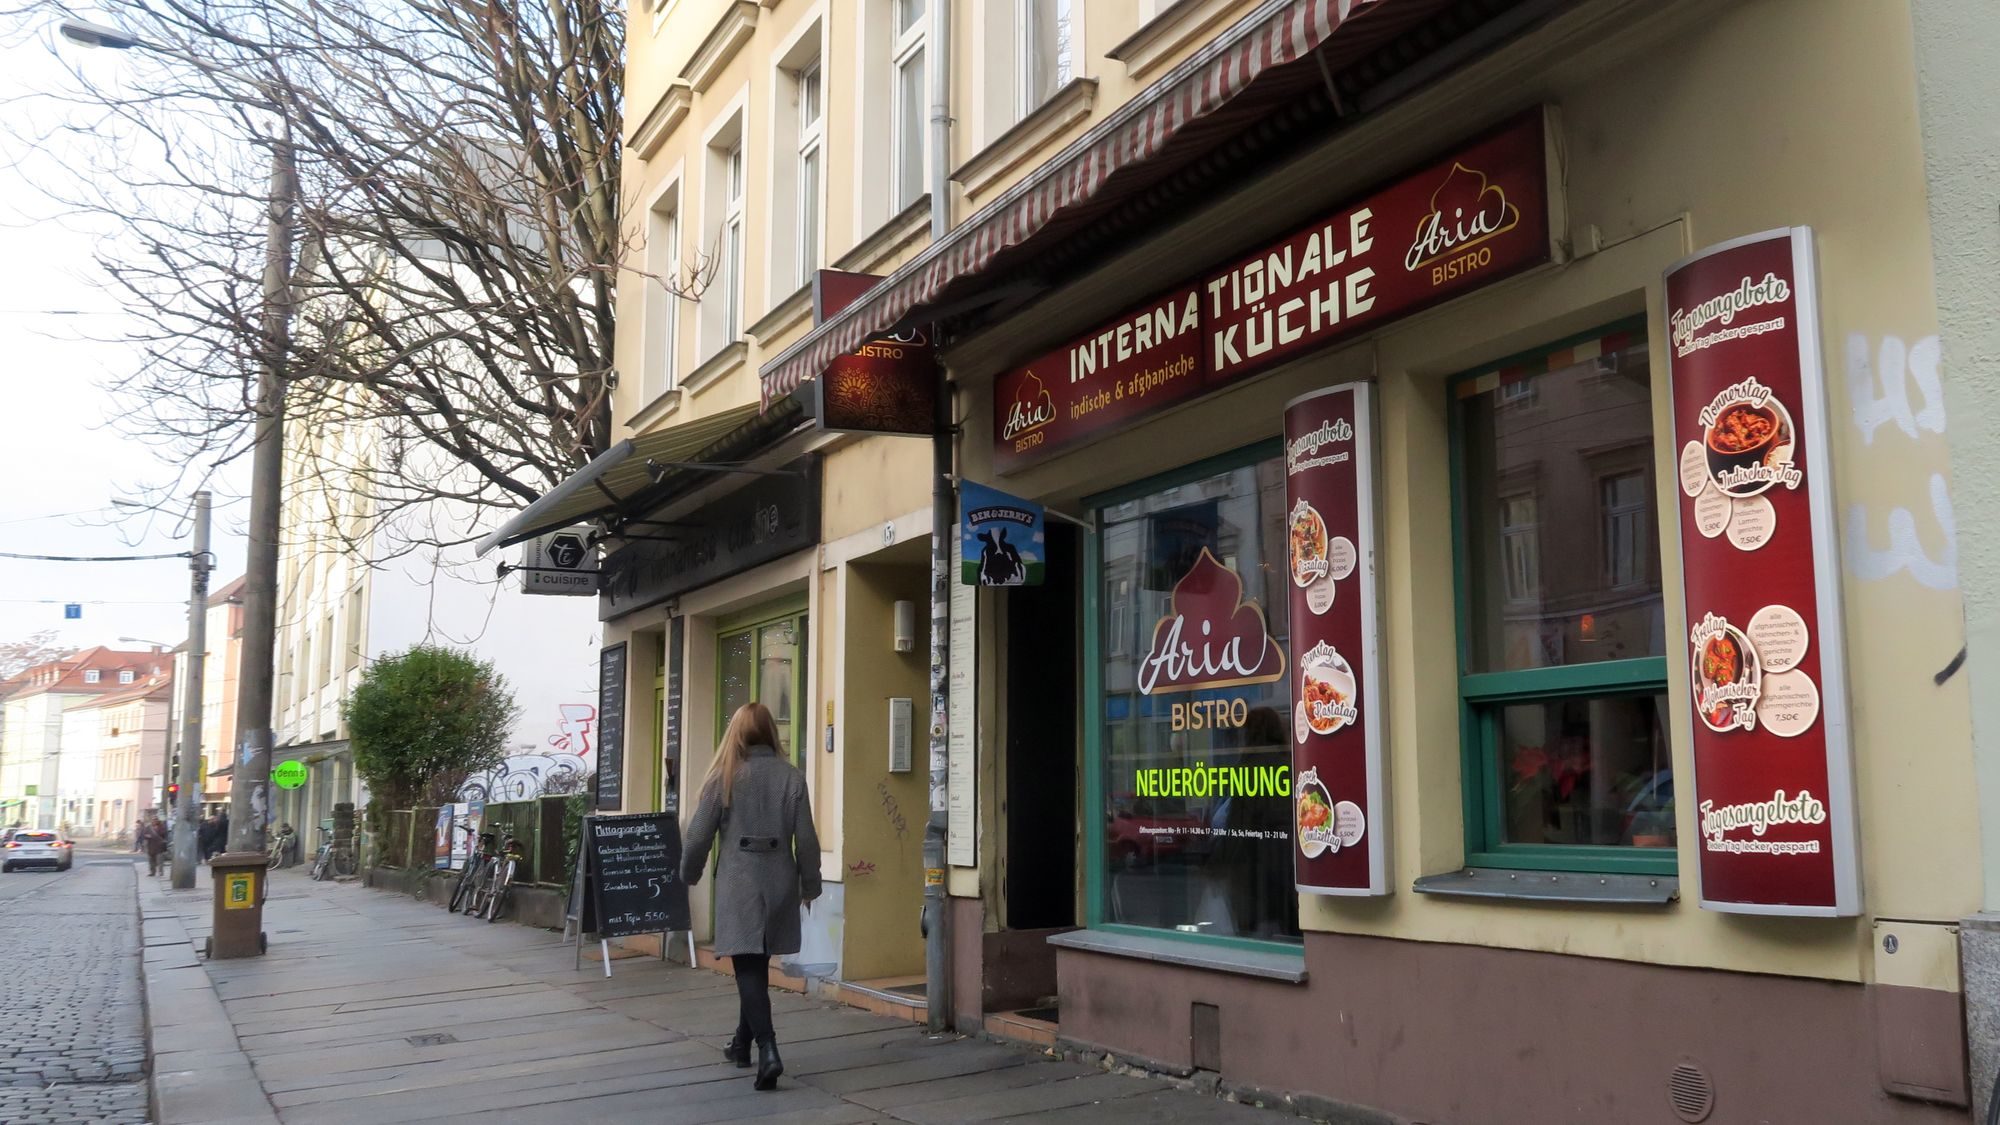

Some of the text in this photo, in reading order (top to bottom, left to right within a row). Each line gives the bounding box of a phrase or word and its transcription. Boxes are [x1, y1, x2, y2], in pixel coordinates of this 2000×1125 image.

[1405, 207, 1506, 272] Aria
[1432, 247, 1492, 287] BISTRO
[1214, 266, 1376, 372] KÜCHE
[1672, 273, 1789, 346] Tagesangebote
[1697, 337, 1711, 349] Tag
[1712, 329, 1738, 344] lecker
[1740, 317, 1784, 338] gespart!
[1070, 354, 1195, 420] indische & afghanische
[1699, 377, 1771, 427] Donnerstag
[1003, 401, 1051, 441] Aria
[1015, 431, 1044, 453] BISTRO
[1719, 462, 1773, 490] Indischer
[1775, 461, 1800, 488] Tag
[543, 575, 589, 585] cuisine
[1692, 612, 1727, 648] Freitag
[1138, 614, 1267, 696] Aria
[1302, 641, 1334, 671] Dienstag
[1171, 697, 1248, 731] BISTRO
[1314, 701, 1356, 724] Pastatag
[1733, 703, 1755, 730] Tag
[1136, 762, 1291, 797] NEUERÖFFNUNG
[1701, 790, 1825, 839] Tagesangebote
[1708, 840, 1818, 854] Jeden Tag lecker gespart!
